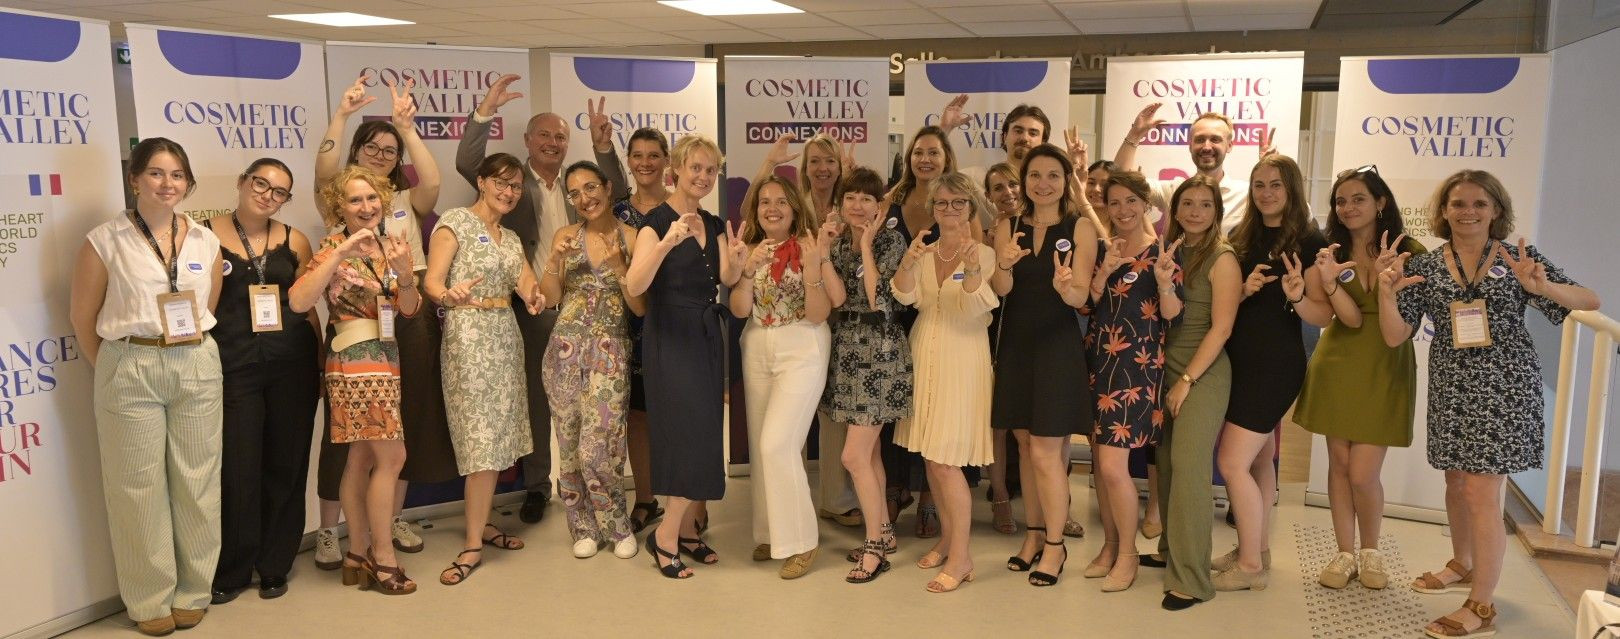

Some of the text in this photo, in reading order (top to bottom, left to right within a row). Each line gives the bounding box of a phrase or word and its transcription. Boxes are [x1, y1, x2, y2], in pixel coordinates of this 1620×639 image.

[745, 78, 869, 97] COSMETIC
[1132, 78, 1271, 98] COSMETIC
[408, 92, 486, 113] VALLE
[786, 100, 869, 119] VALLEY
[164, 100, 307, 126] COSMETIC
[575, 112, 697, 132] CSMETIC
[1361, 116, 1515, 136] COSMETIC
[215, 126, 308, 149] VALLEY
[1409, 136, 1515, 158] VALLEY
[0, 212, 44, 225] HEART
